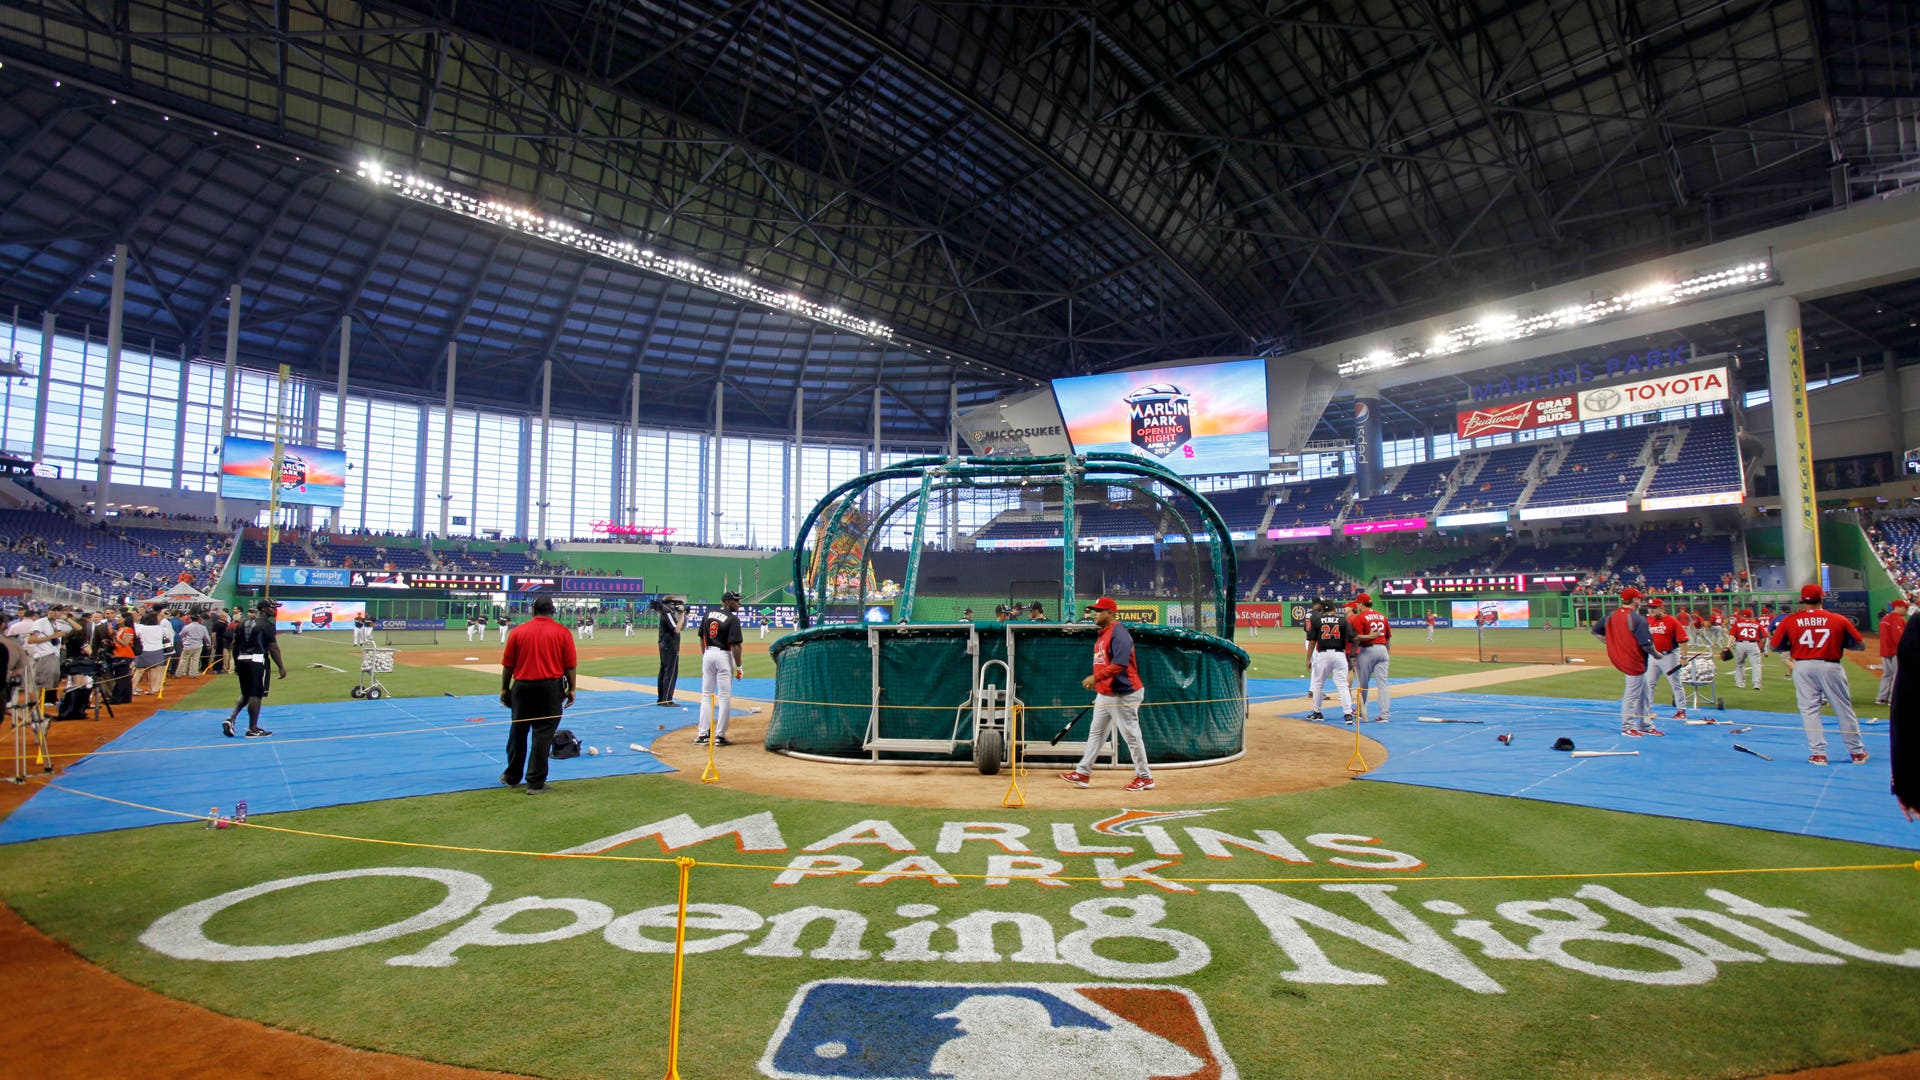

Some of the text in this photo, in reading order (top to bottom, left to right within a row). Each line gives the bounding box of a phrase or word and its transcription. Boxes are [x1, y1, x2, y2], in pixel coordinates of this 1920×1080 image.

[1473, 344, 1688, 401] MARLINS PARK
[1625, 374, 1722, 402] TOYOTA
[1536, 398, 1572, 411] GRAB
[1543, 406, 1566, 415] SOME
[1126, 402, 1198, 424] MARLINS
[1463, 411, 1529, 429] Budweiser
[1537, 411, 1573, 424] BUDS
[1144, 416, 1177, 428] PARK
[985, 426, 1061, 441] MICCOSUKEE
[1137, 426, 1184, 436] OPENING
[1144, 433, 1177, 443] NIGHT
[1356, 425, 1369, 464] pepsi
[311, 570, 342, 580] simply
[565, 579, 641, 591] CLEVELANDER
[168, 602, 182, 610] THE
[1115, 612, 1153, 621] STANLEY
[1796, 617, 1828, 628] MABRY
[708, 620, 719, 639] 8
[1320, 624, 1341, 640] 24
[1740, 628, 1757, 639] 43
[1798, 628, 1831, 649] 47
[538, 810, 1428, 872] MARLINS
[771, 855, 1198, 895] PARK
[138, 866, 1920, 995] Opening Night
